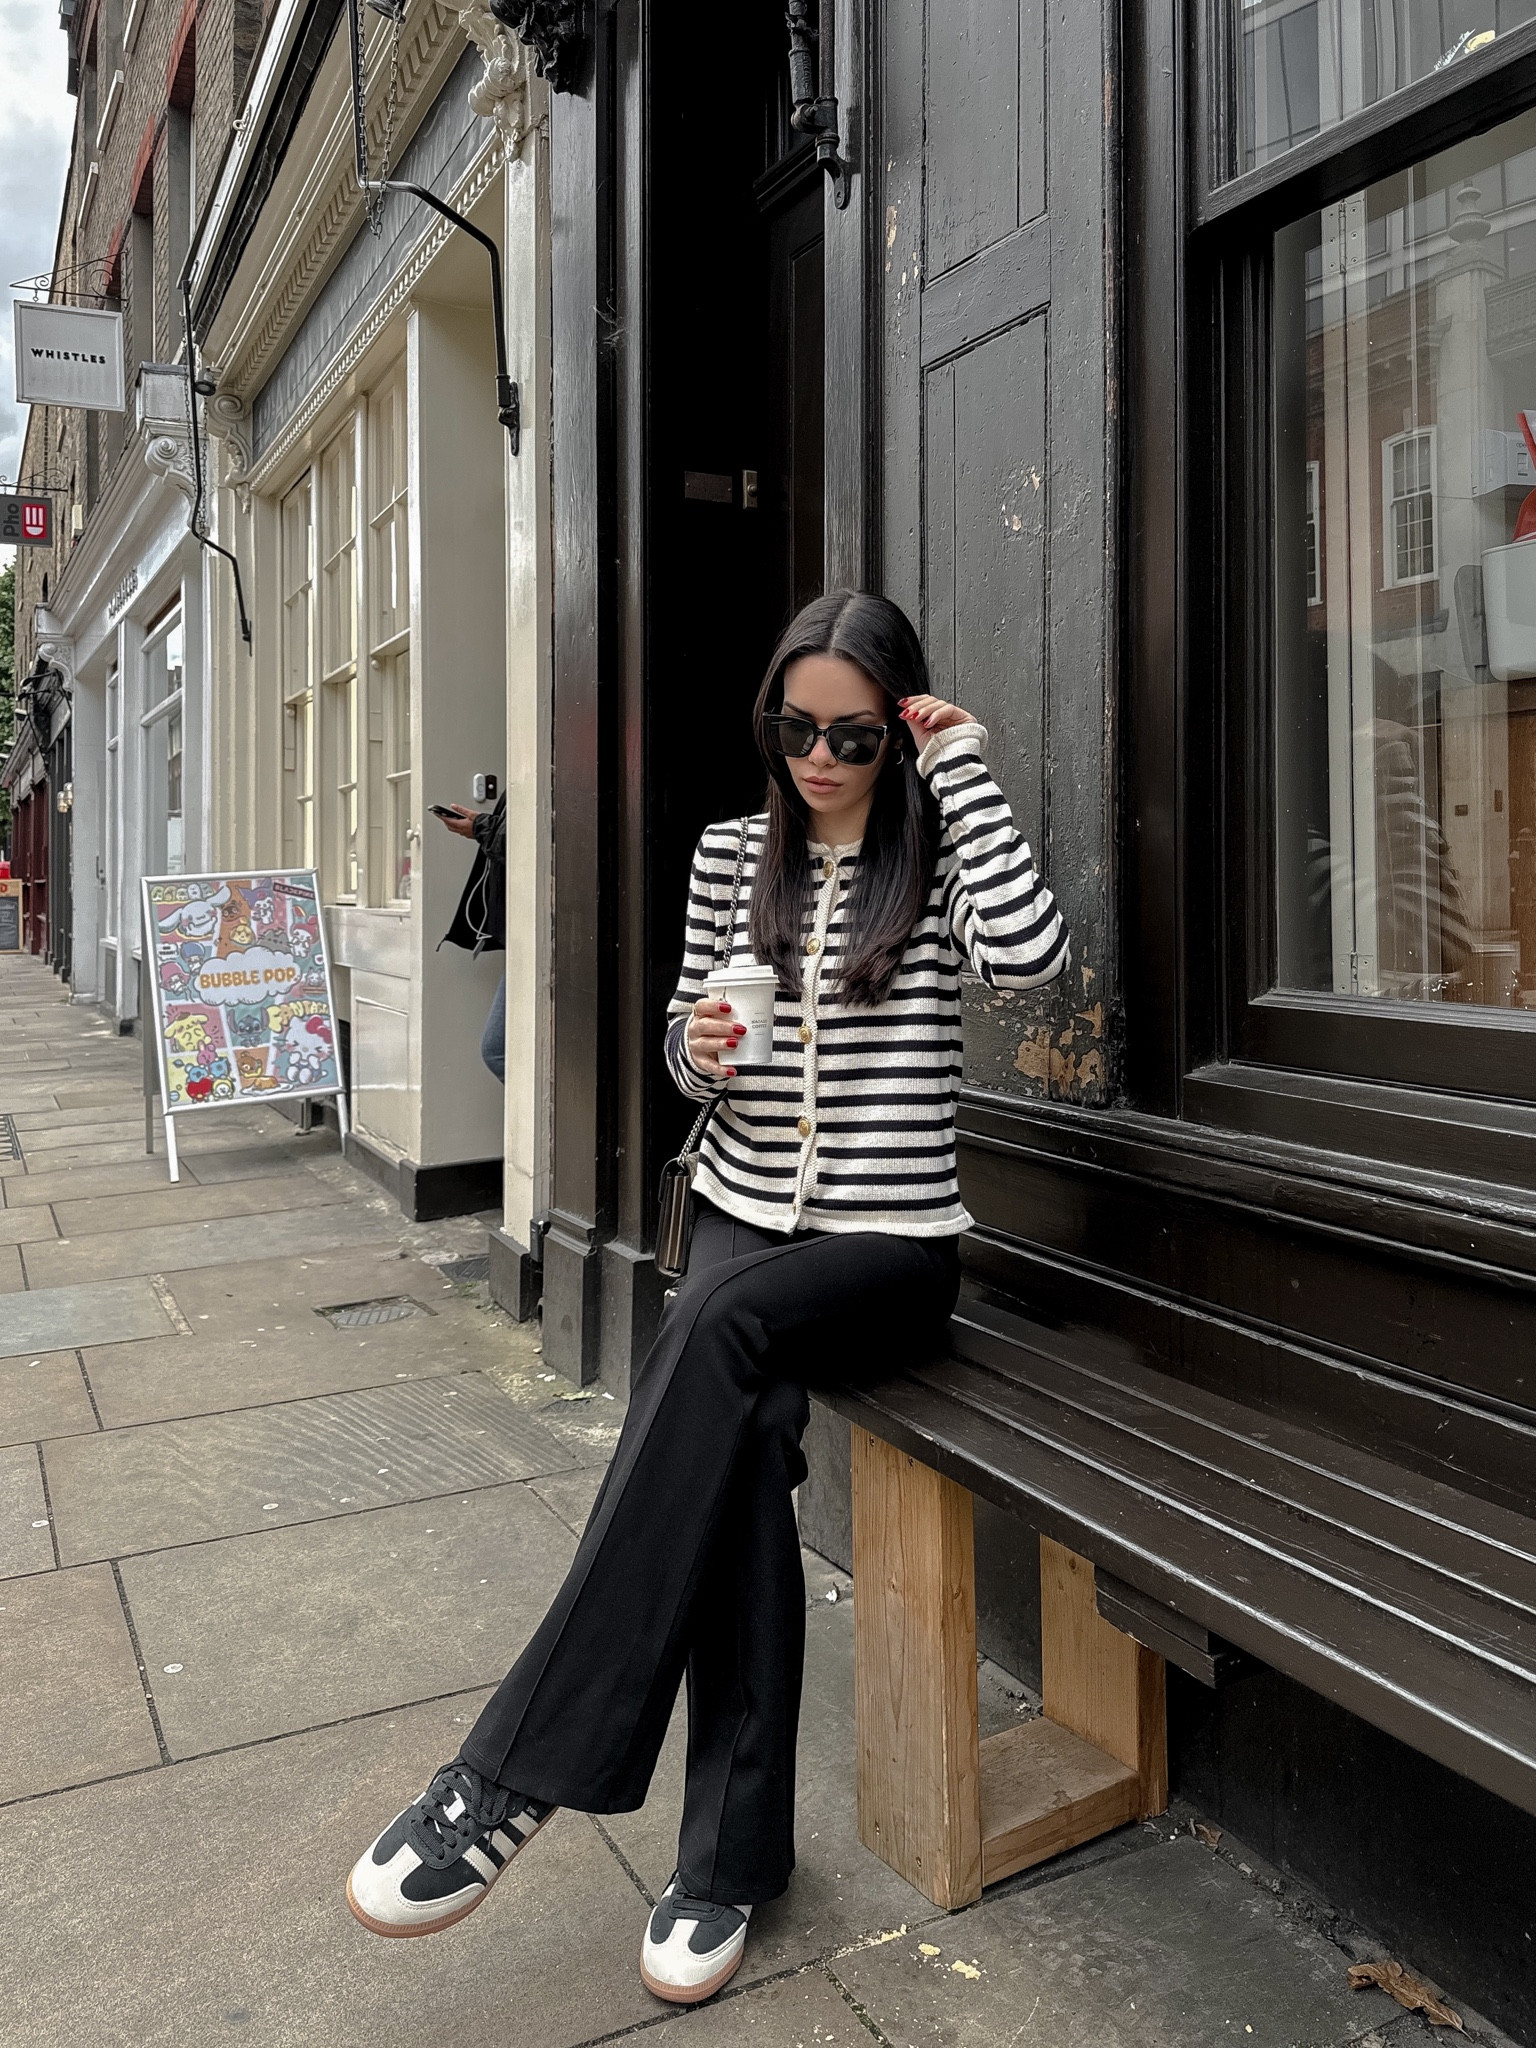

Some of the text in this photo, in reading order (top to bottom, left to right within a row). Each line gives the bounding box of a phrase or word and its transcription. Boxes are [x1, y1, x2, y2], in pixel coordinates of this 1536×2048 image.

[30, 347, 106, 364] WHISTLES
[3, 503, 20, 537] Pho
[200, 967, 295, 989] BUBBLE POP
